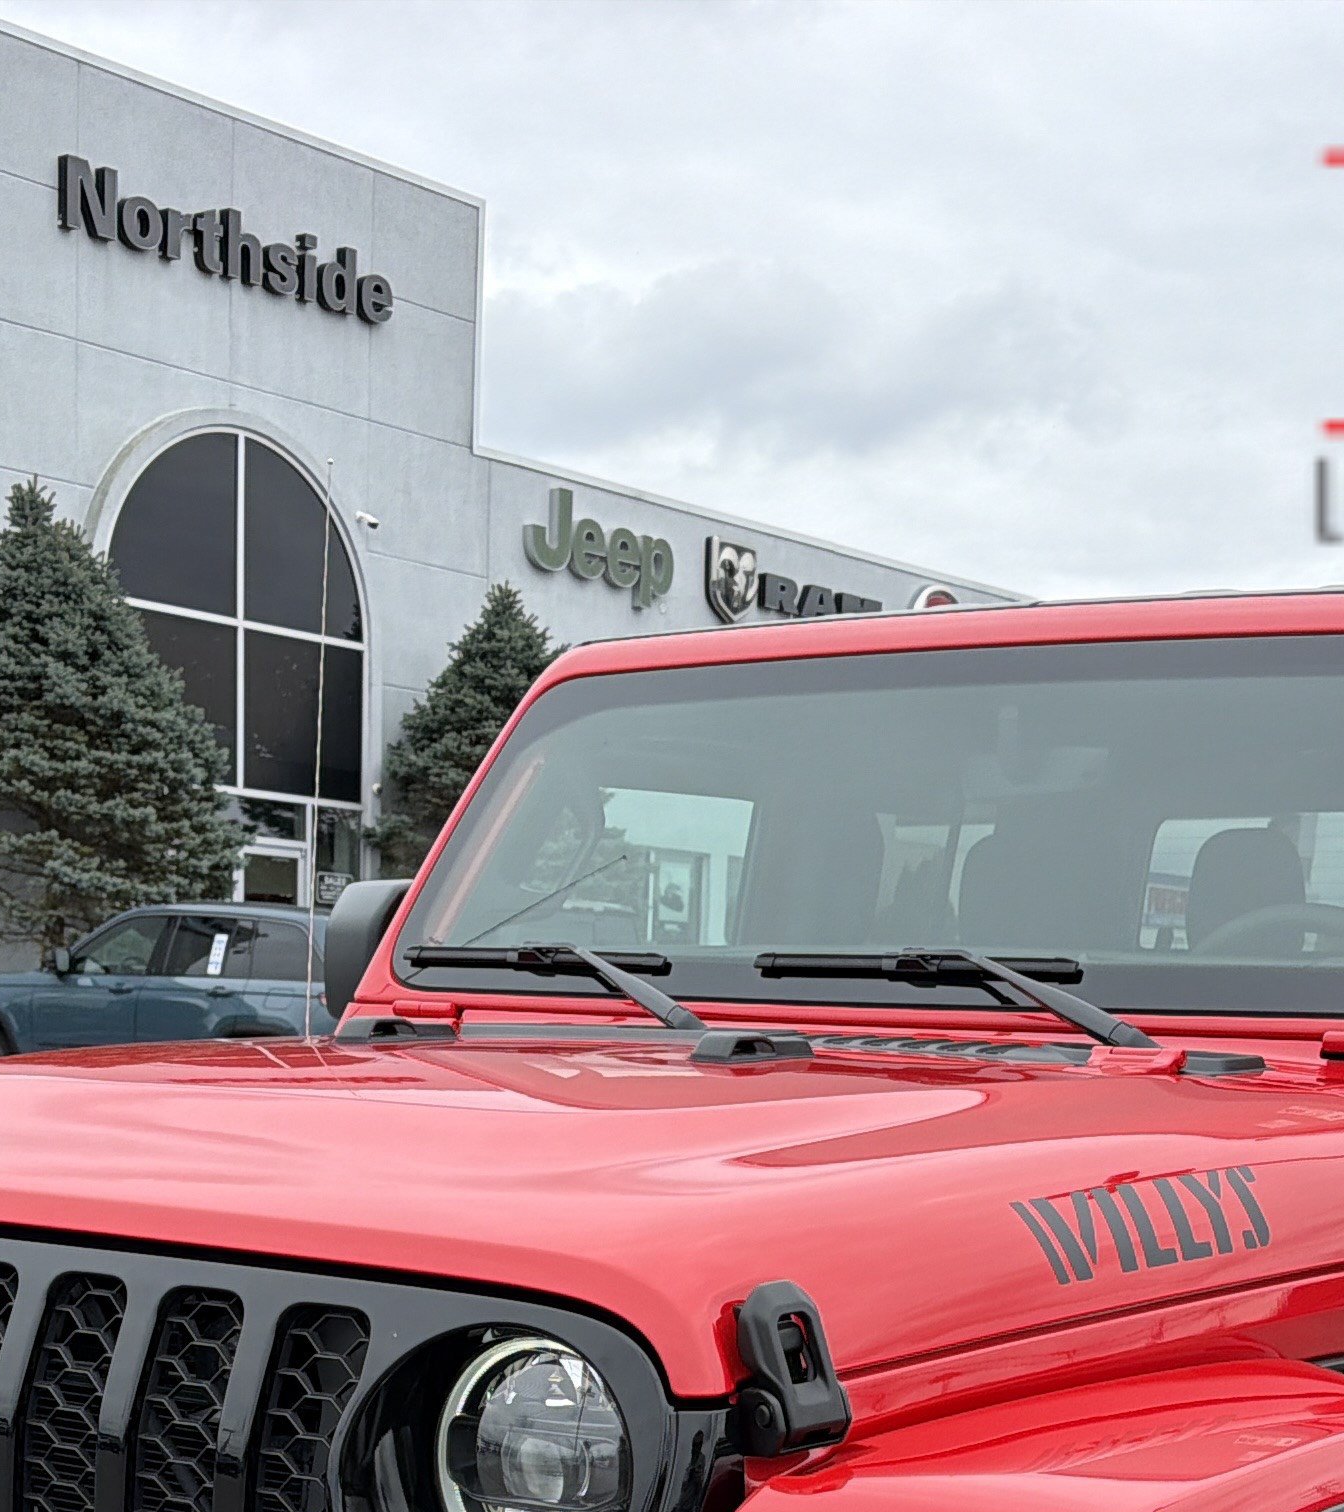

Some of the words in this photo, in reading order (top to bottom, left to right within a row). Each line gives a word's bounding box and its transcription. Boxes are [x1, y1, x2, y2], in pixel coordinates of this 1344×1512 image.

[57, 153, 394, 325] Northside
[523, 487, 675, 611] Jeep
[1009, 1165, 1270, 1285] WILLYS
